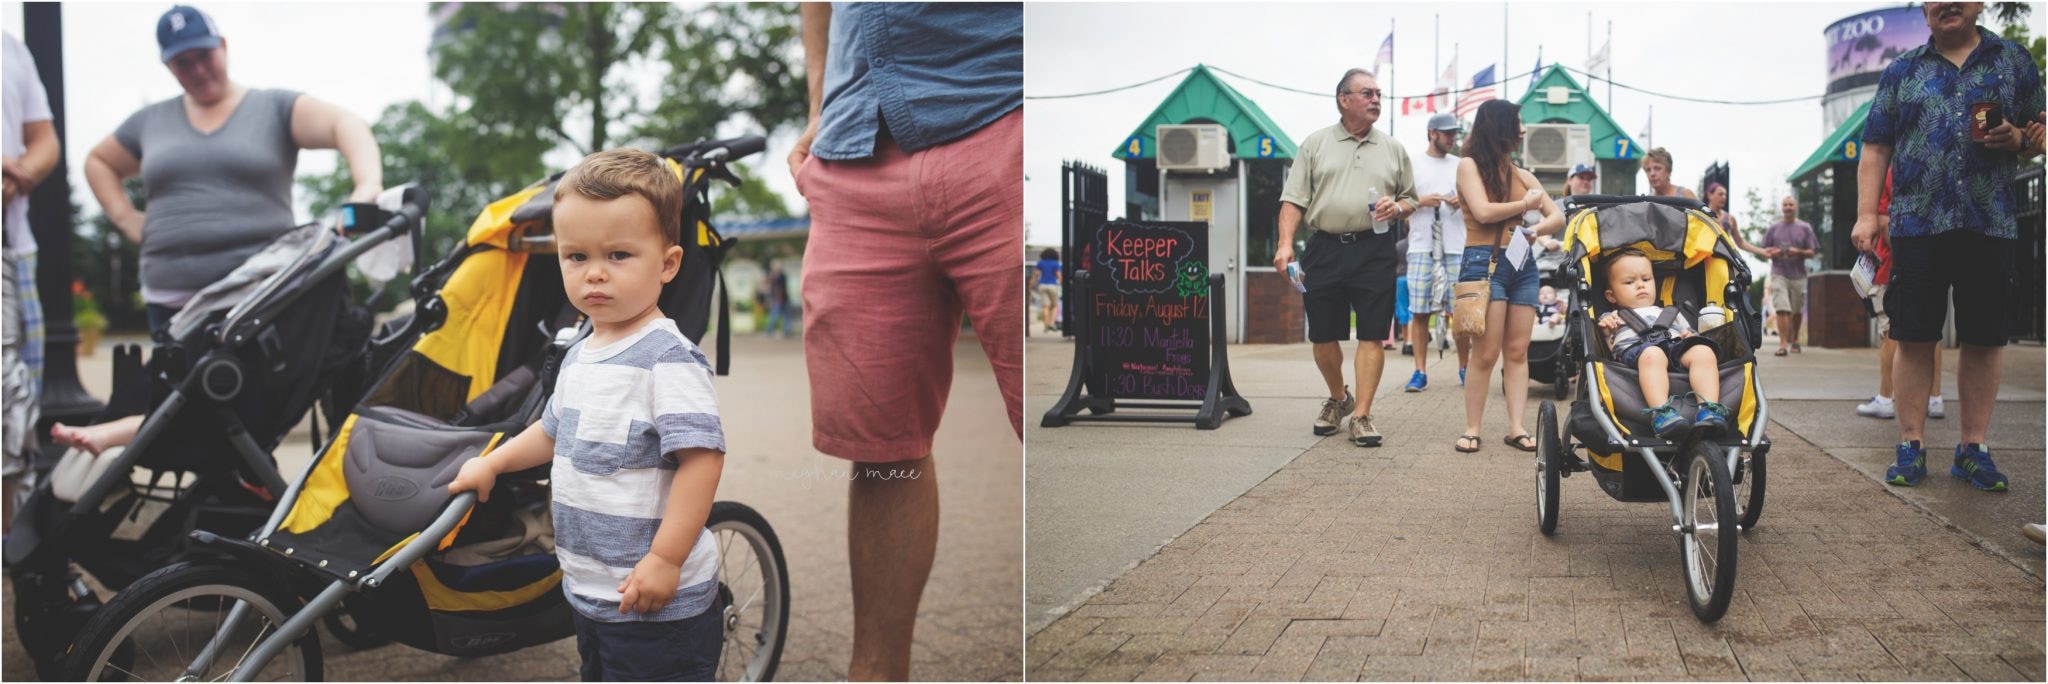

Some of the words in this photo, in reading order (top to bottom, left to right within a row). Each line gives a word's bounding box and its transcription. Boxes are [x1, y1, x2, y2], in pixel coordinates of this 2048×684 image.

[1841, 15, 1884, 41] ZOO
[1129, 138, 1141, 156] 4
[1261, 138, 1272, 156] 5
[1617, 139, 1629, 157] 7
[1845, 141, 1857, 158] 8
[1107, 230, 1177, 258] Keeper
[1119, 258, 1165, 281] Talks
[1145, 294, 1190, 326] August
[1193, 295, 1208, 318] 12
[1101, 326, 1134, 347] 11:30
[1144, 327, 1193, 348] Mantella
[1166, 348, 1191, 364] Frogs
[1105, 374, 1135, 395] 1:30
[1178, 376, 1205, 400] Dogs
